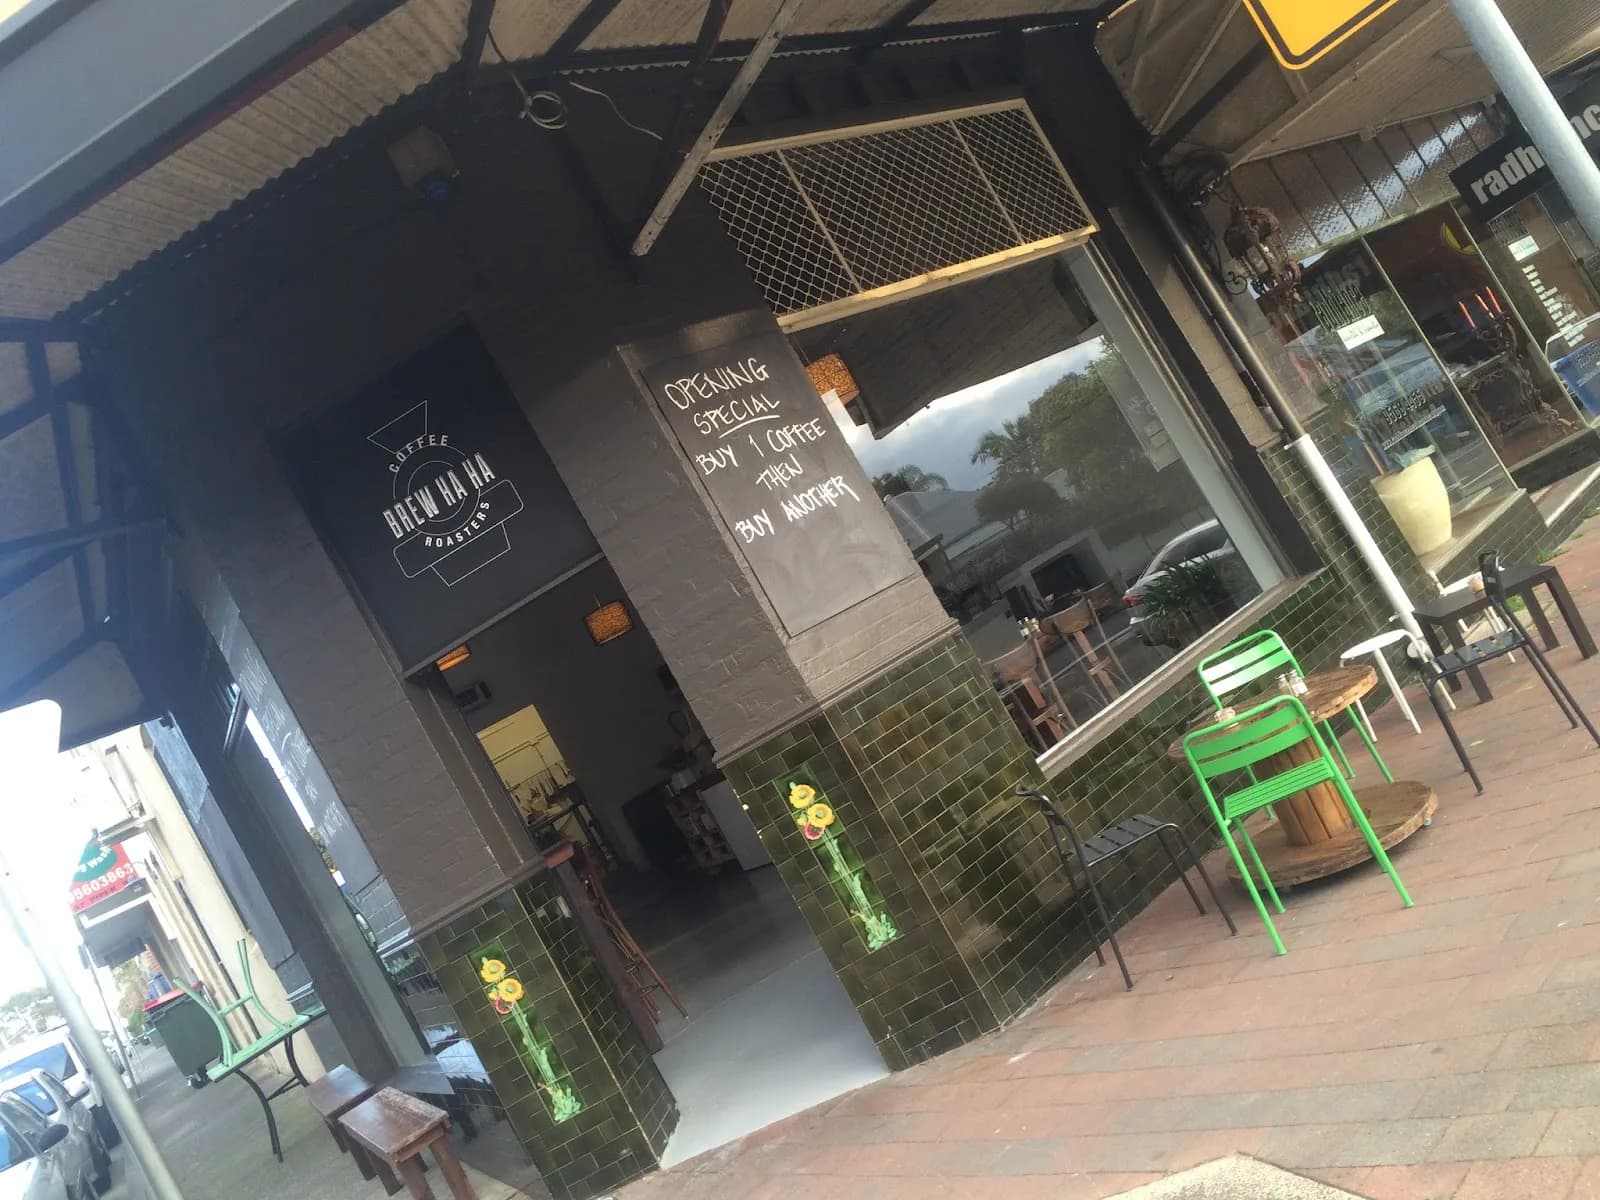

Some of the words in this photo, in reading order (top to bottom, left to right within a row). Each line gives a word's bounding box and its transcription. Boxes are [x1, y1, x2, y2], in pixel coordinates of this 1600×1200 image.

[664, 357, 770, 410] OPENING
[693, 393, 780, 435] SPECIAL
[388, 434, 449, 474] COFFEE
[695, 444, 739, 475] BUY
[748, 434, 765, 457] 1
[766, 417, 826, 452] COFFEE
[382, 485, 440, 539] BREW
[434, 469, 469, 507] HA
[461, 451, 496, 490] HA
[756, 453, 804, 490] THEN
[424, 501, 490, 548] ROASTERS
[735, 508, 775, 543] BUY
[780, 475, 860, 522] ANOTHER
